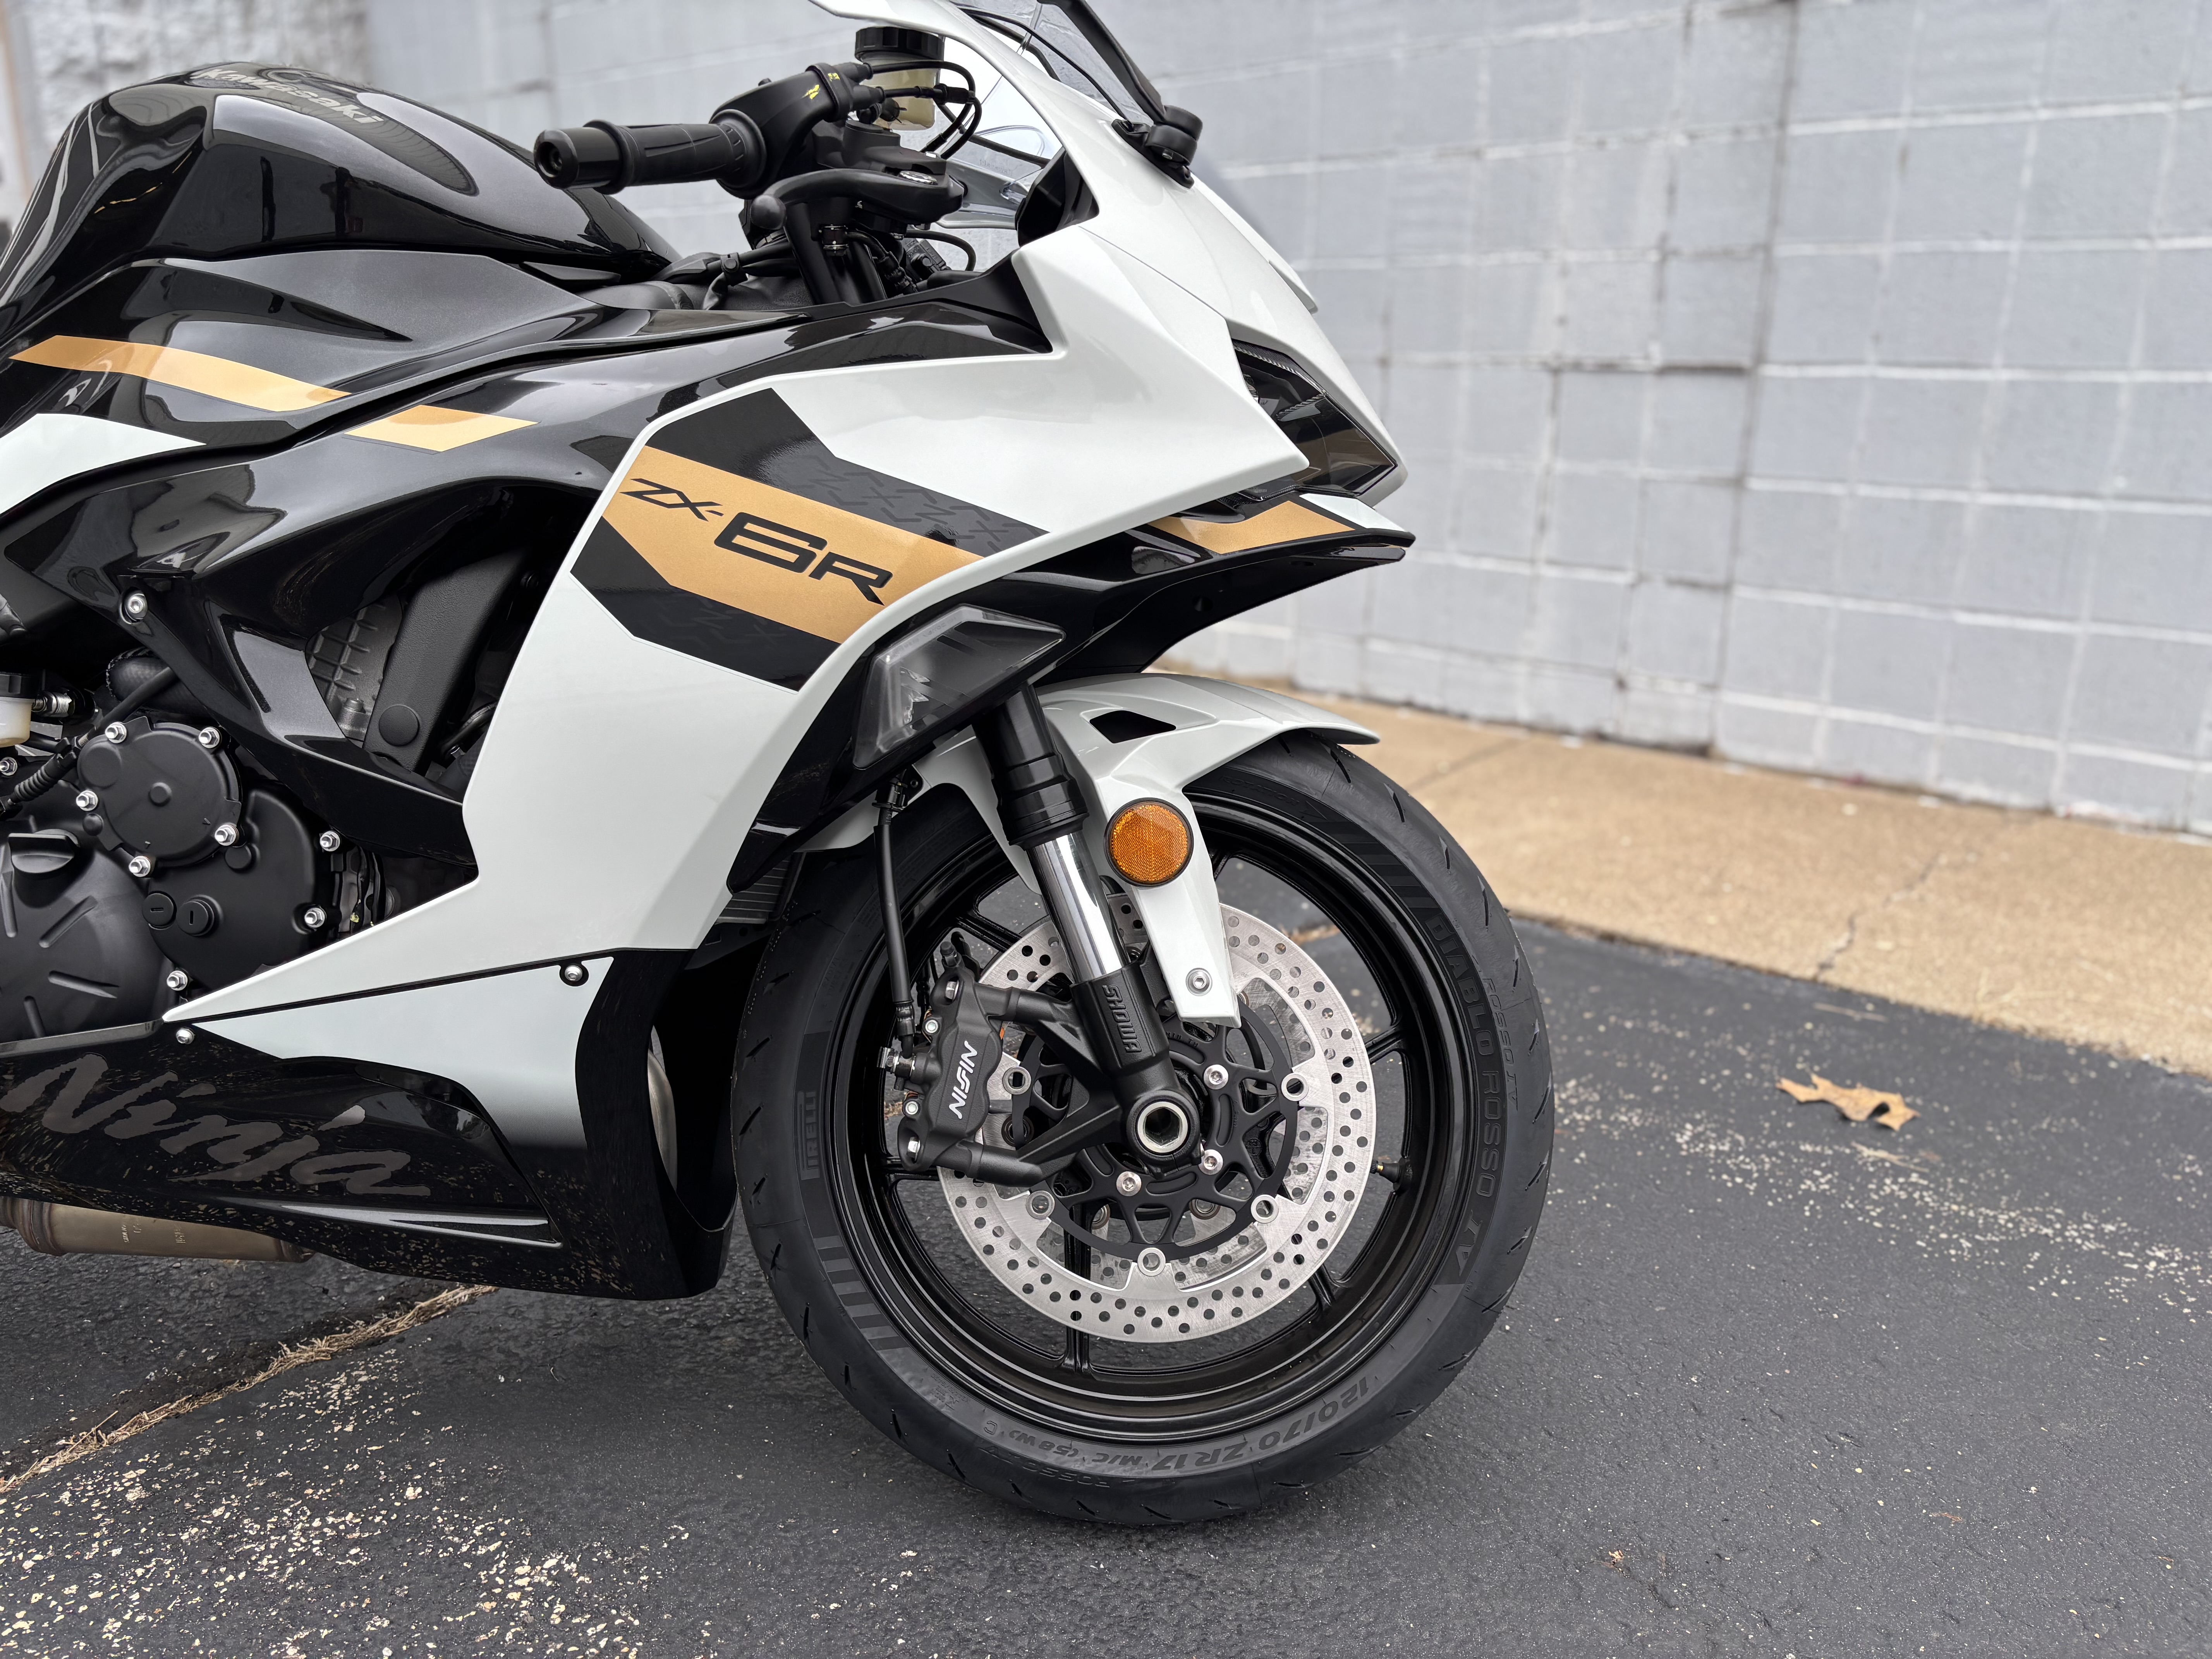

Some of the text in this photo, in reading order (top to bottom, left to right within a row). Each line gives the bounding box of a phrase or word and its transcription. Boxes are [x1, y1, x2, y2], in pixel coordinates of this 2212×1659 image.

[190, 69, 385, 124] Kawasaki
[619, 477, 894, 606] ZX-6R
[1102, 984, 1142, 1053] SHOWA
[1423, 913, 1496, 1057] DIABLO
[1475, 1070, 1501, 1198] ROSSO
[0, 1052, 431, 1196] Ninja
[797, 1090, 821, 1180] PIRELLI
[1259, 1376, 1369, 1450] 120/70
[1091, 1452, 1143, 1466] M/C
